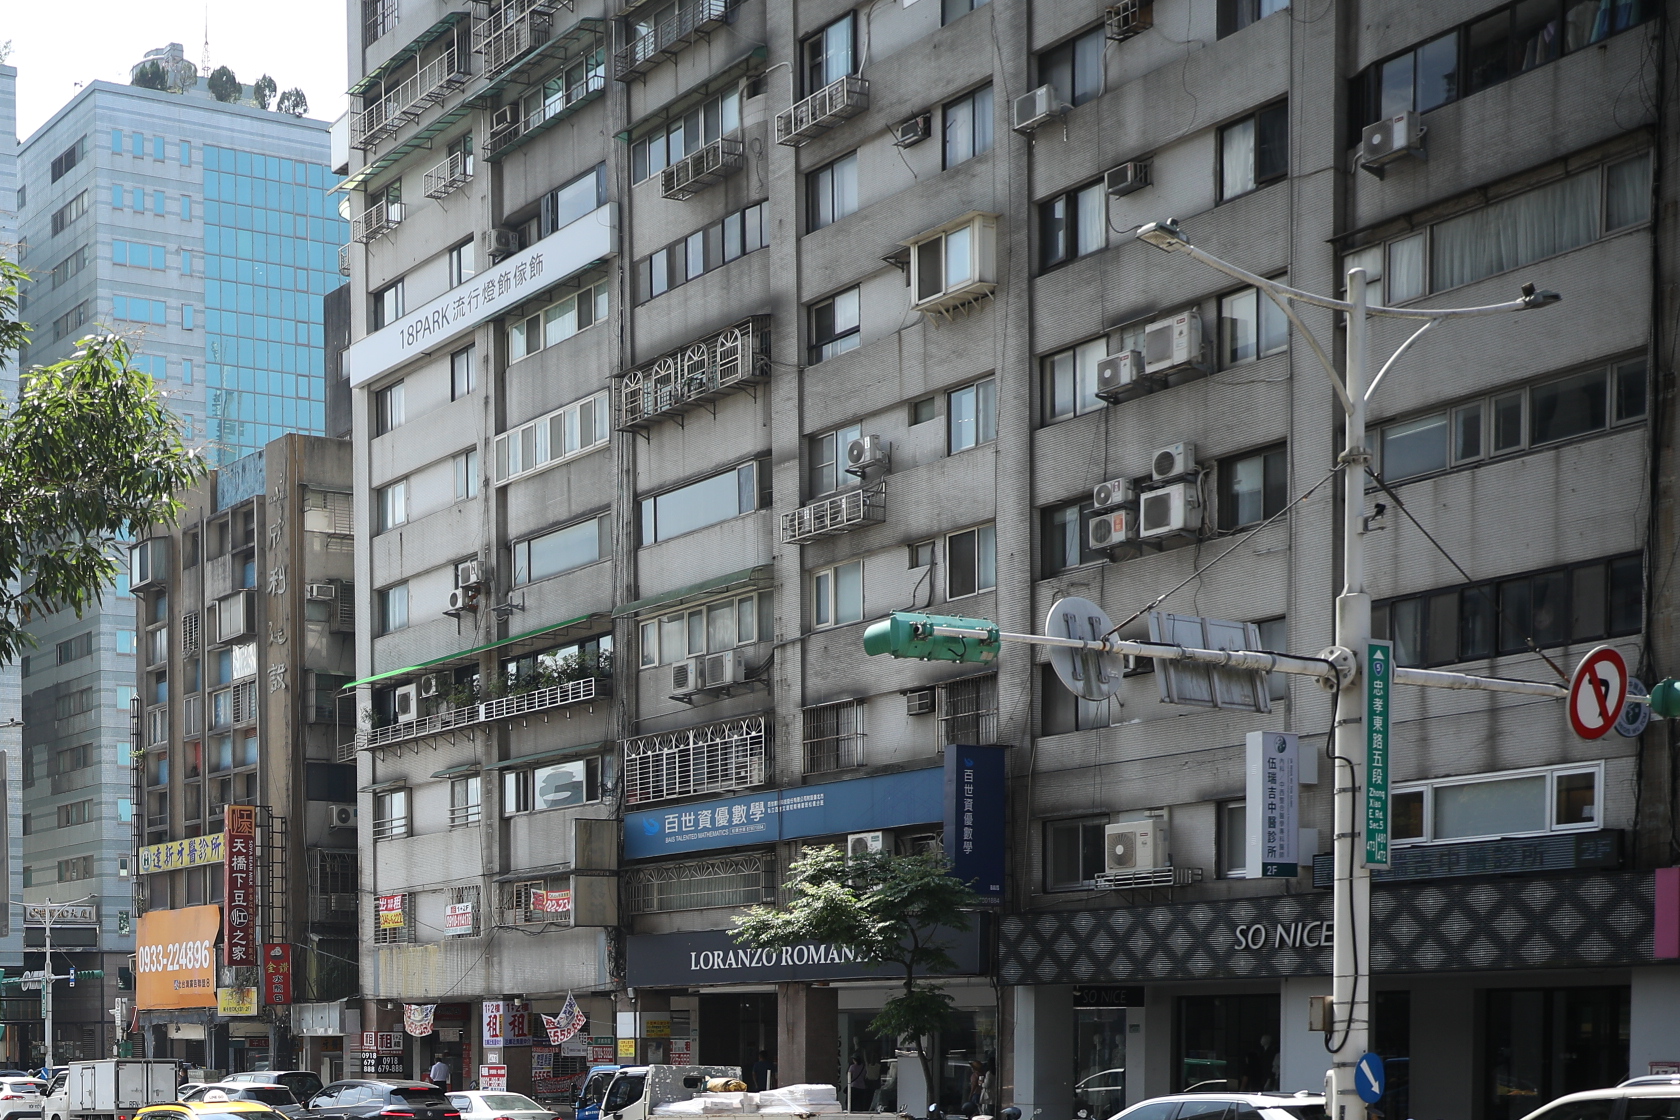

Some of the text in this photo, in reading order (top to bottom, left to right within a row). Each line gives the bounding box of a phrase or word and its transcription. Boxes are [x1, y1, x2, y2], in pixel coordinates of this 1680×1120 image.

[1376, 663, 1381, 672] 5
[1373, 680, 1383, 785] 忠孝東路五段
[1369, 787, 1385, 799] Zhong
[1369, 799, 1381, 808] Xiao
[664, 801, 766, 834] 百世資優數學
[963, 769, 974, 855] 百世資優數學
[676, 832, 698, 842] TALENTED
[698, 828, 729, 839] MATHEMATICS
[152, 835, 222, 869] 達新牙醫診所
[1266, 865, 1277, 876] 2F
[457, 904, 469, 913] 1+2F
[1234, 920, 1334, 950] SO NICE
[138, 939, 210, 973] 0933-224896
[690, 946, 777, 971] LORANZO
[272, 975, 284, 1002] 水煎包
[1083, 989, 1127, 1003] SO NICE
[487, 1014, 499, 1038] 租
[509, 1013, 528, 1038] 租
[364, 1034, 374, 1045] 租
[379, 1034, 392, 1049] 租
[382, 1057, 398, 1065] 0918
[378, 1065, 403, 1073] 679-888
